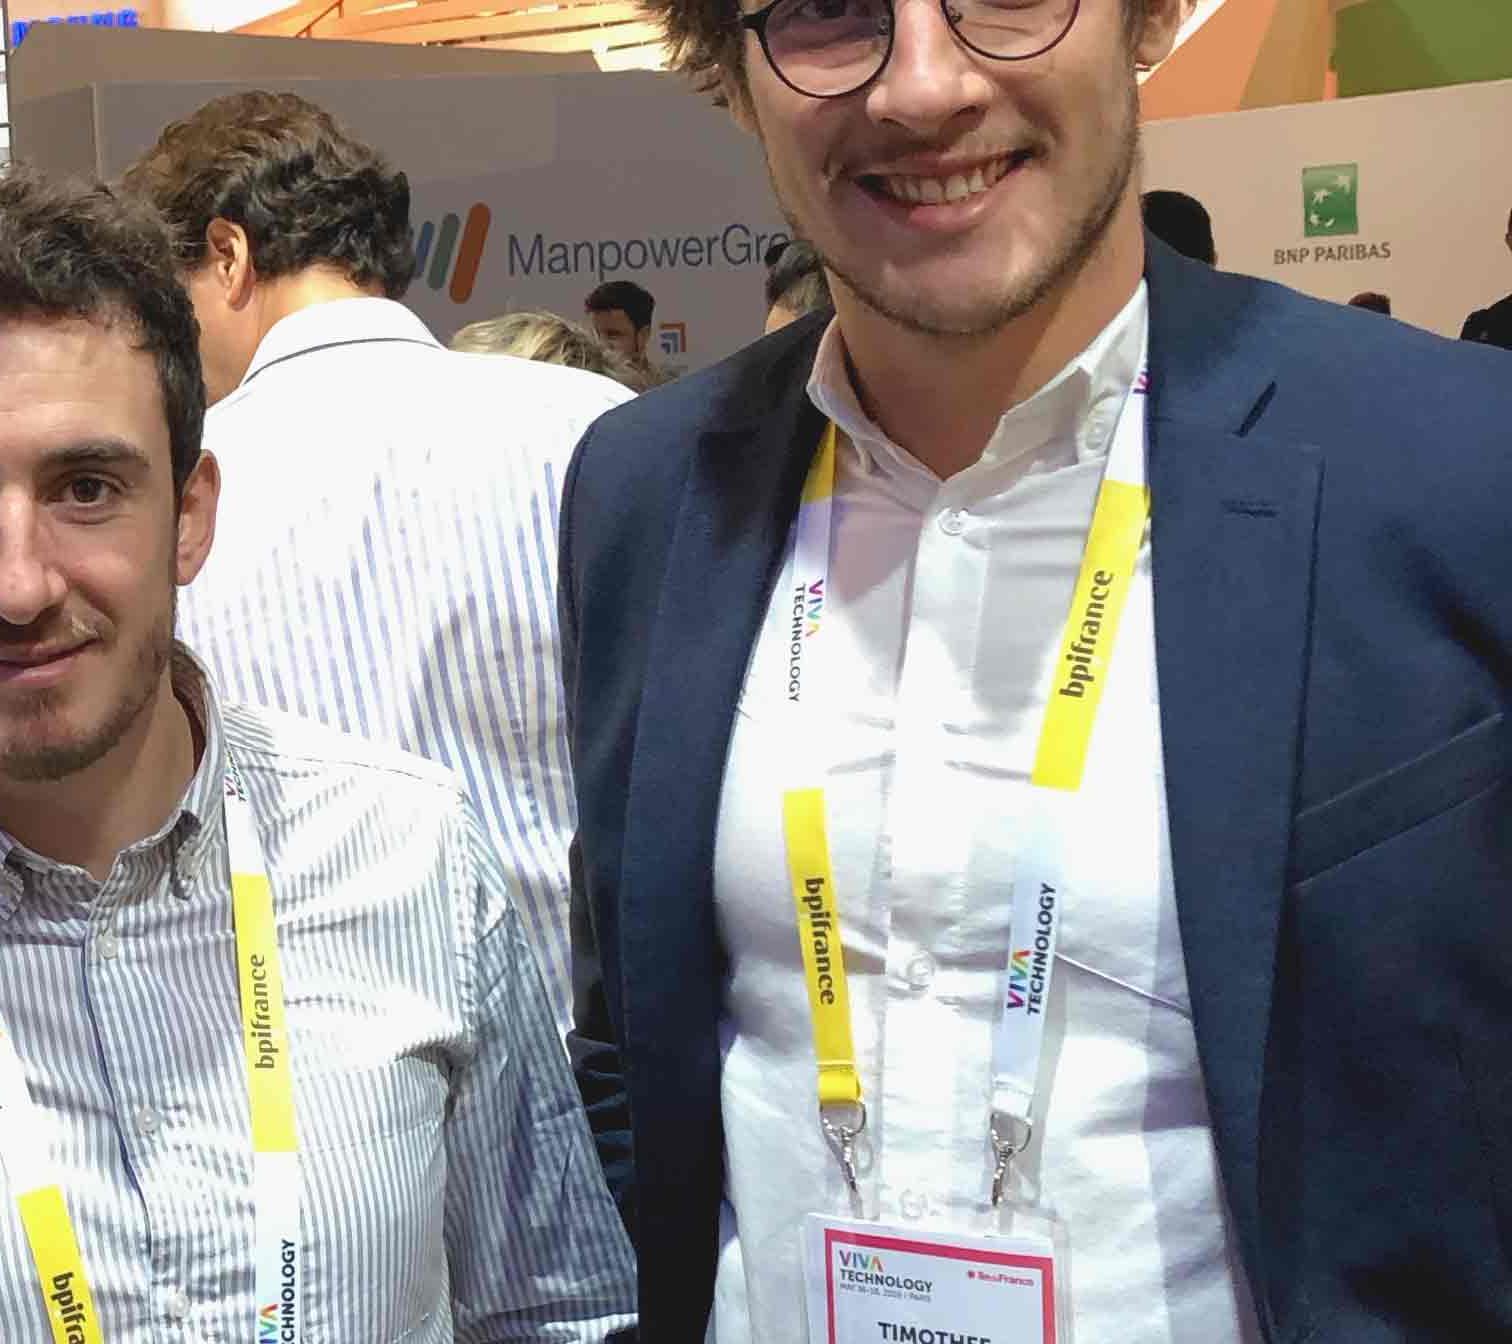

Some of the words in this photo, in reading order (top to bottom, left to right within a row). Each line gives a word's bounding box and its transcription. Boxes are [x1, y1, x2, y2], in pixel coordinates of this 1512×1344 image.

[507, 223, 789, 282] ManpowerGr
[1273, 247, 1310, 265] BNP
[1314, 241, 1392, 263] PARIBAS
[807, 577, 825, 640] VIVA
[1058, 568, 1115, 700] bpifrance
[787, 583, 807, 703] TECHNOLOGY
[804, 876, 836, 1007] bpifrance
[1026, 882, 1058, 1016] TECHNOLOGY
[251, 953, 276, 1070] bpifrance
[1006, 949, 1032, 1011] VIVA
[840, 1251, 883, 1272] VIVA
[841, 1269, 932, 1292] TECHNOLOGY
